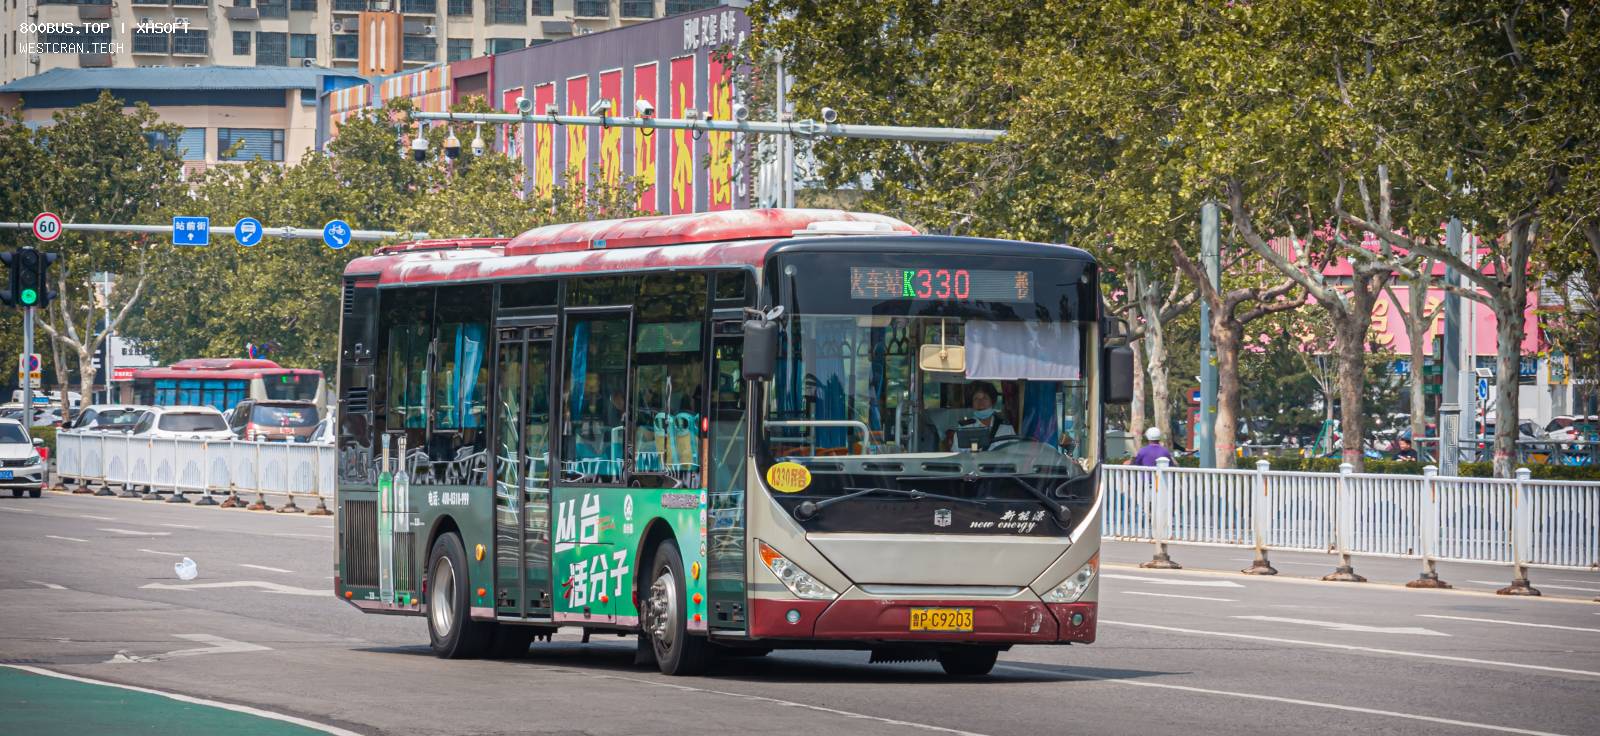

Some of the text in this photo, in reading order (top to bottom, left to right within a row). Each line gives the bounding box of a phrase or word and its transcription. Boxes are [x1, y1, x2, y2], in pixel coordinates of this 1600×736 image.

[39, 221, 55, 233] 60
[175, 221, 207, 231] 站前街
[903, 269, 969, 299] K330
[1000, 510, 1046, 521] 新能源
[555, 492, 600, 553] 丛台
[970, 521, 1036, 533] new energy
